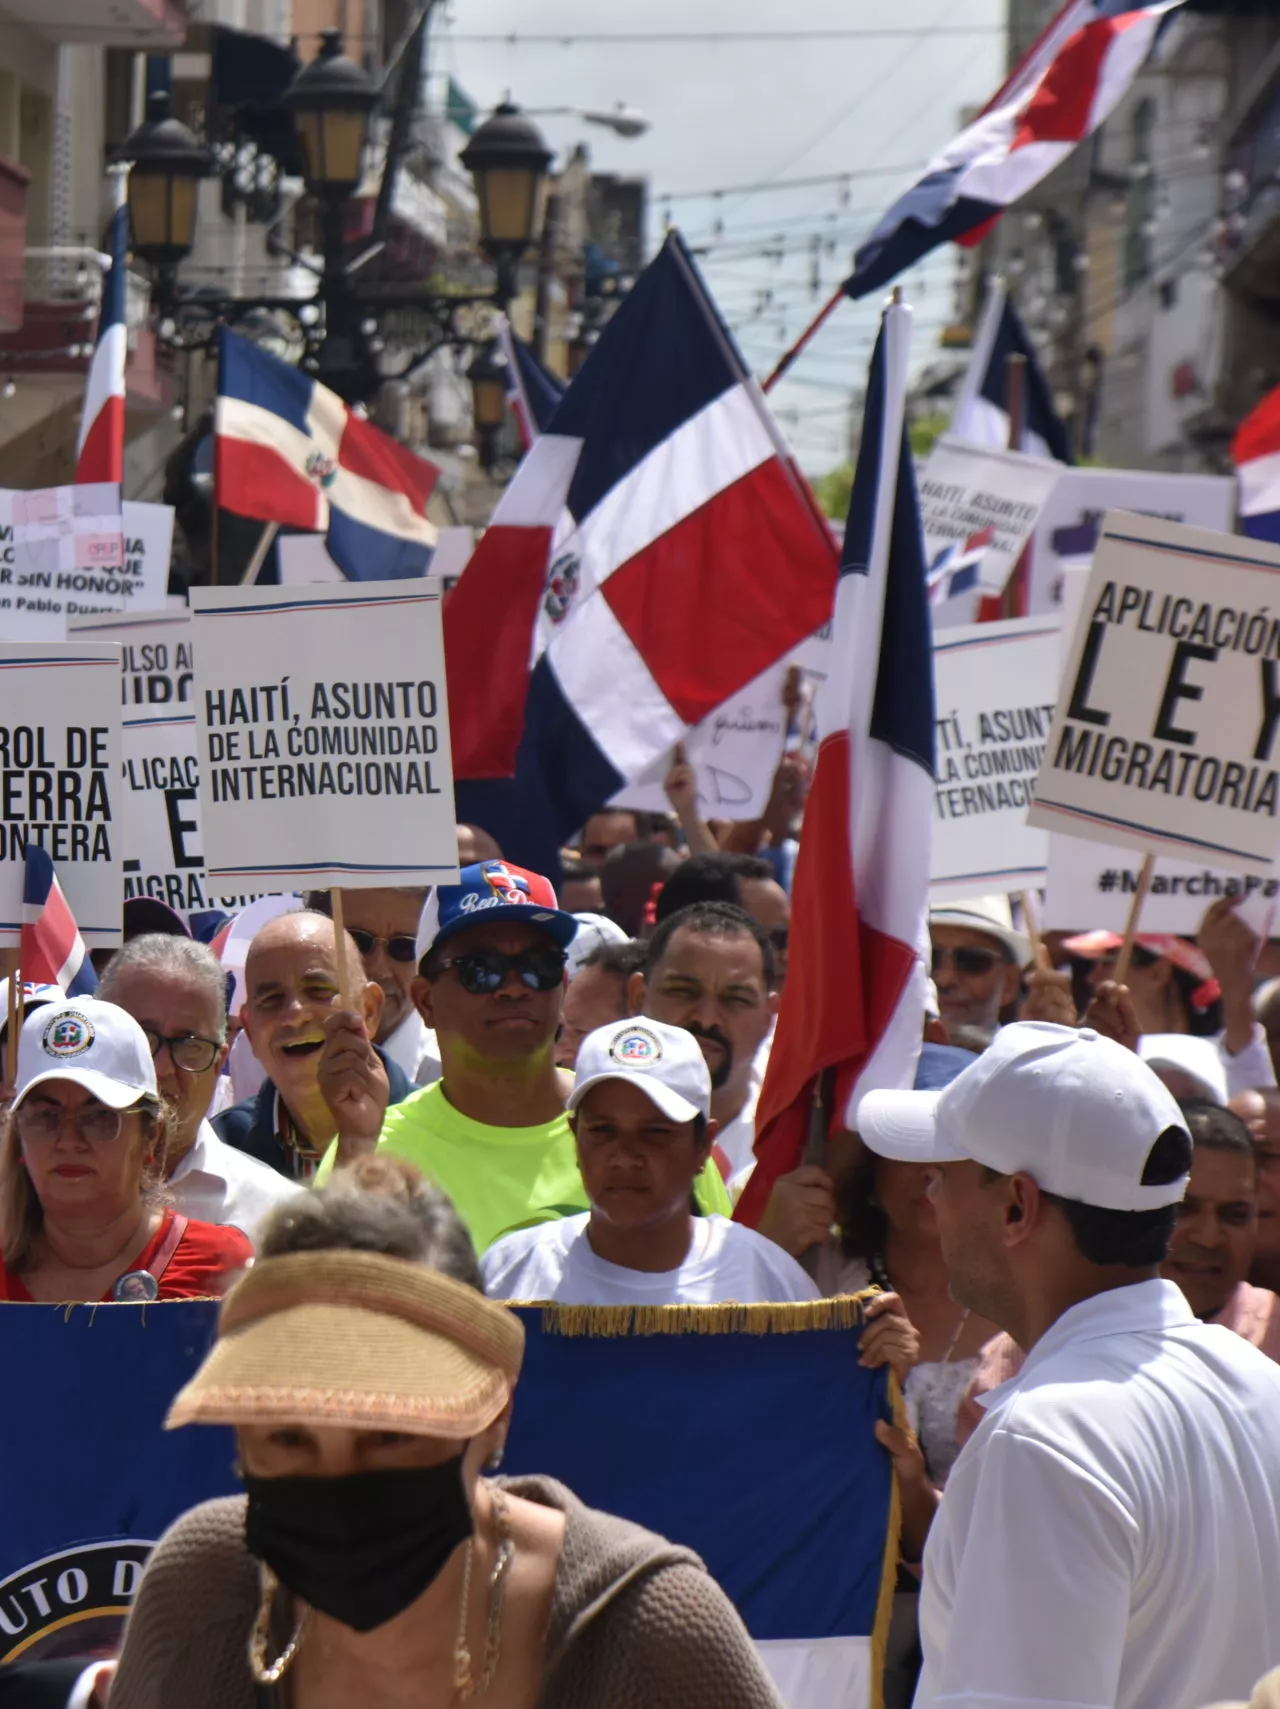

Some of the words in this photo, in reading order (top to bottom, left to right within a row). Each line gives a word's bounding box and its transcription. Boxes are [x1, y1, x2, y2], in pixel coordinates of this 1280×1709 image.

[17, 596, 62, 614] Pablo
[205, 676, 300, 727] HAITÍ,
[311, 680, 438, 720] ASUNTO
[67, 727, 109, 768] DE
[208, 731, 241, 762] DE
[248, 728, 280, 760] LA
[287, 725, 438, 757] COMUNIDAD
[211, 760, 441, 802] INTERNACIONAL
[1053, 725, 1280, 817] MIGRATORIA
